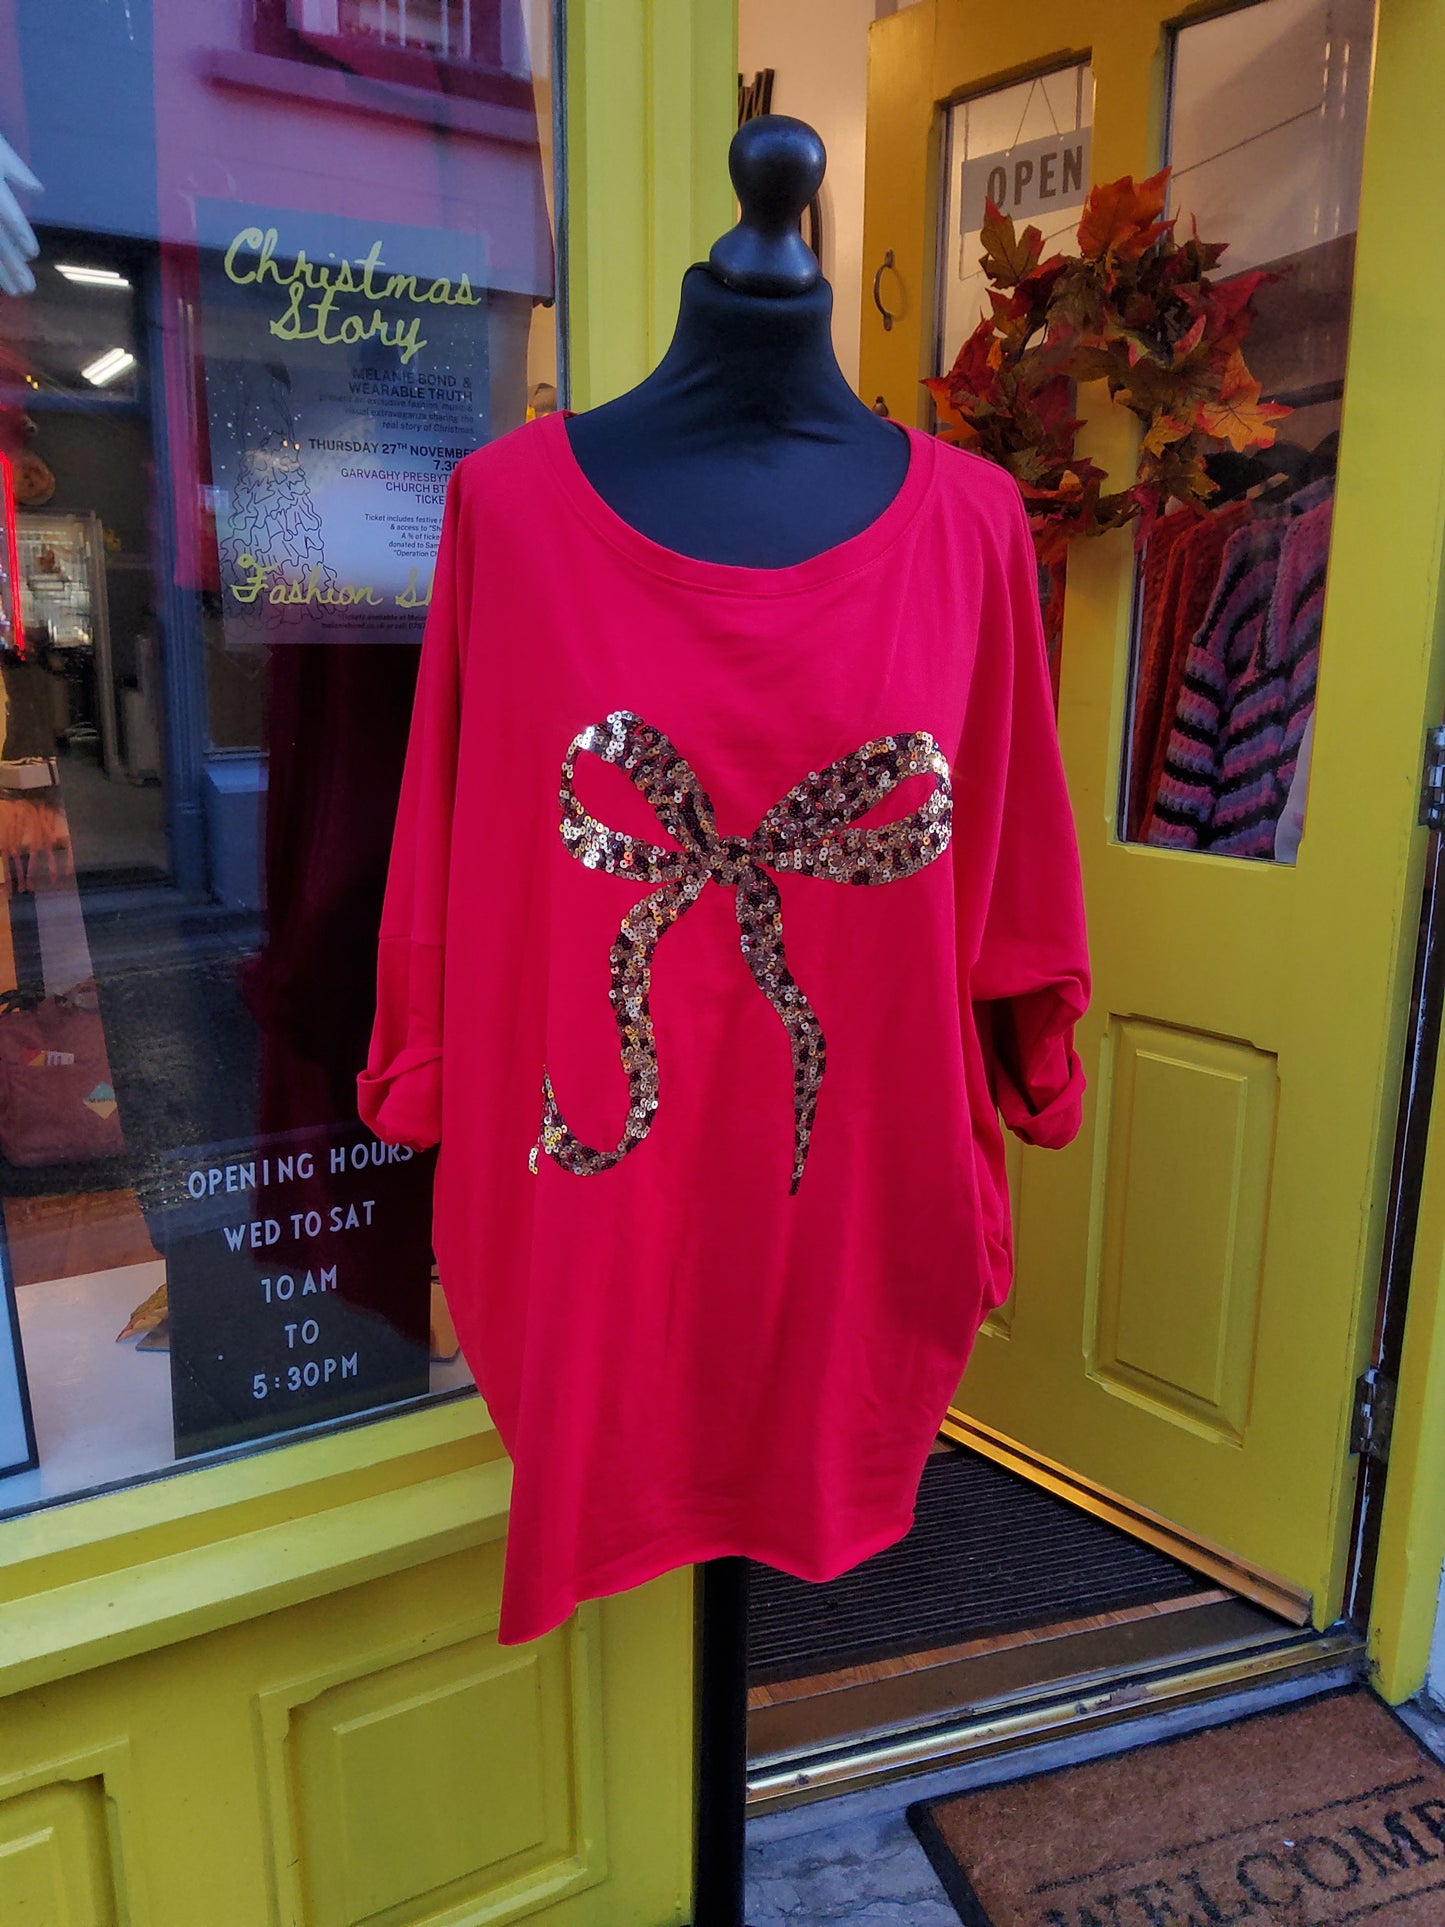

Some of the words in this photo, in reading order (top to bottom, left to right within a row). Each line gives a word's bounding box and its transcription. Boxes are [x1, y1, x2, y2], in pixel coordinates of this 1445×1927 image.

[987, 145, 1083, 209] OPEN
[224, 227, 481, 305] Christmas
[270, 282, 427, 364] Story
[352, 368, 415, 384] MELANIE
[418, 373, 457, 388] BOND
[462, 377, 472, 389] &
[349, 382, 425, 399] WEARABLE
[428, 388, 473, 402] TRUTH
[371, 408, 427, 421] extravaganza
[428, 412, 458, 424] sharing
[461, 414, 473, 423] the
[382, 422, 399, 431] real
[400, 423, 422, 433] story
[423, 424, 432, 432] of
[433, 425, 474, 435] Christmas
[308, 438, 378, 453] THURSDAY
[341, 468, 400, 480] GARVAGHY
[403, 471, 451, 483] PRESBYT
[386, 482, 430, 493] CHURCH
[433, 484, 448, 493] BT
[415, 495, 445, 505] TICKE
[365, 513, 385, 521] Ticket
[415, 516, 437, 524] festive
[230, 554, 383, 606] Fashion
[188, 1153, 314, 1198] OPENING
[331, 1142, 413, 1174] HOURS
[223, 1219, 281, 1252] WED
[290, 1211, 322, 1239] TO
[329, 1201, 376, 1232] SAT
[285, 1320, 319, 1348] TO
[252, 1352, 358, 1400] 5:30PM
